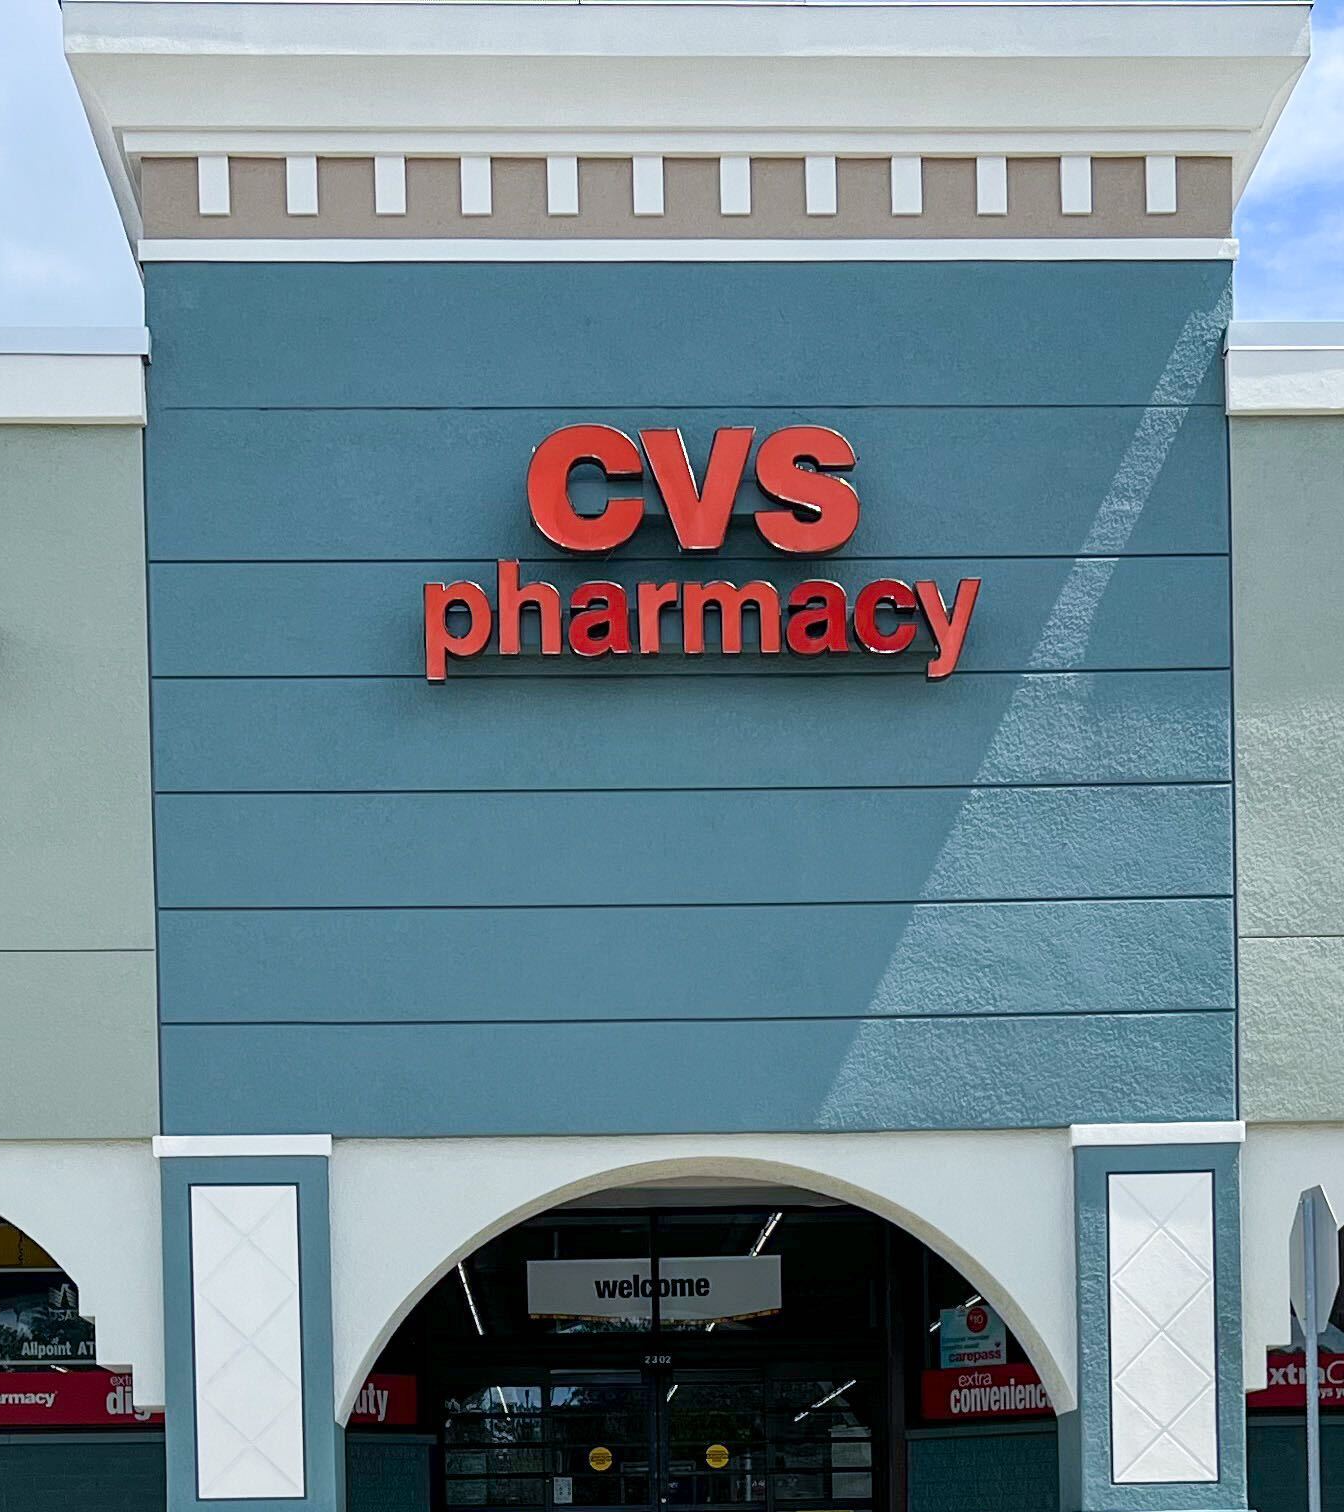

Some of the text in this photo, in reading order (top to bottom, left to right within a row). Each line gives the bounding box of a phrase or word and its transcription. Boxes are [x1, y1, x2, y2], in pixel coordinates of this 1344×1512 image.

[527, 423, 860, 554] CVS
[423, 559, 981, 683] pharmacy
[594, 1275, 710, 1298] welcome
[21, 1340, 71, 1358] Allpoint
[948, 1350, 1001, 1363] carepass
[958, 1371, 992, 1387] extra
[352, 1383, 388, 1421] uty
